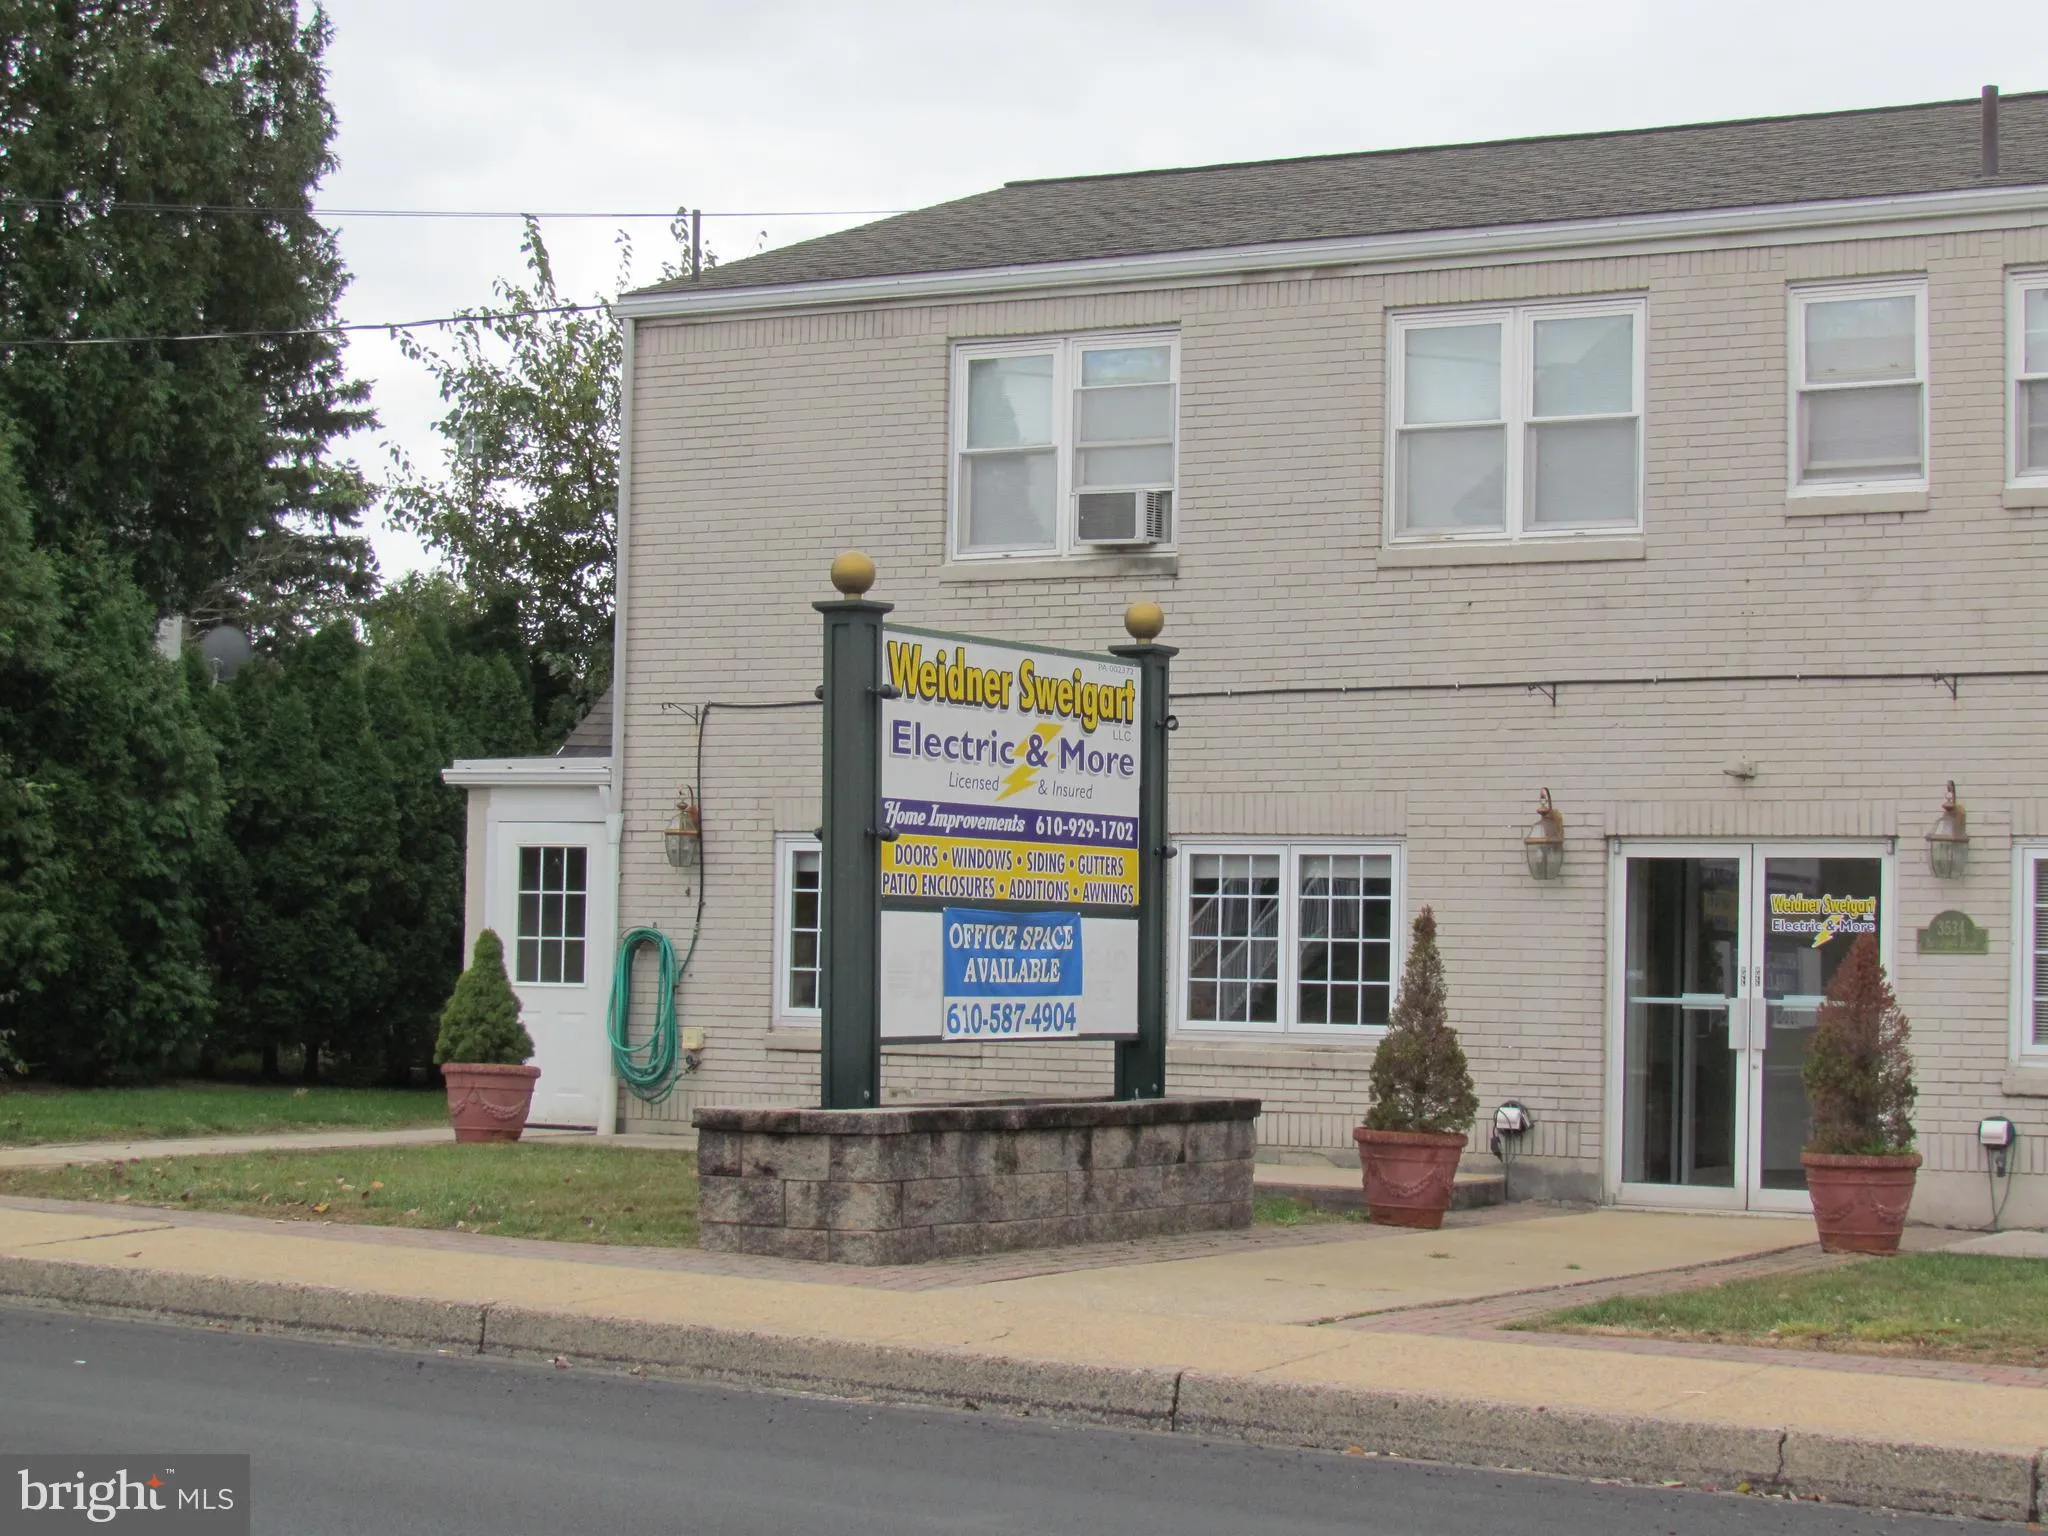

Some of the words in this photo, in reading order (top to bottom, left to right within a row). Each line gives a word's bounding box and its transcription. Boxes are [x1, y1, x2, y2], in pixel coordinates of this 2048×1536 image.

[887, 641, 1013, 710] Weidner
[1019, 659, 1136, 734] Sweigart
[892, 719, 1015, 765] Electric
[1026, 734, 1048, 767] &
[1061, 738, 1135, 776] More
[949, 771, 999, 791] Licensed
[1038, 779, 1048, 795] &
[1053, 783, 1093, 799] Insured
[884, 800, 926, 828] Home
[928, 804, 1026, 833] Improvements
[1035, 815, 1134, 841] 610-929-1702
[895, 843, 938, 867] DOORS
[951, 846, 1013, 871] WINDOWS
[1027, 851, 1065, 873] SIDING
[1078, 855, 1124, 877] GUTTERS
[883, 872, 917, 895] PATIO
[921, 874, 995, 899] ENCLOSURES
[1009, 878, 1069, 901] ADDITIONS
[1082, 882, 1134, 904] AWNINGS
[1770, 893, 1821, 914] Weidner
[1822, 894, 1876, 919] Sweigart
[949, 923, 1016, 949] OFFICE
[1019, 926, 1073, 950] SPACE
[1772, 918, 1822, 932] Electric
[1826, 920, 1836, 932] &
[1840, 919, 1875, 932] More
[963, 957, 1060, 983] AVAILABLE
[946, 1002, 1076, 1034] 610-587-4904
